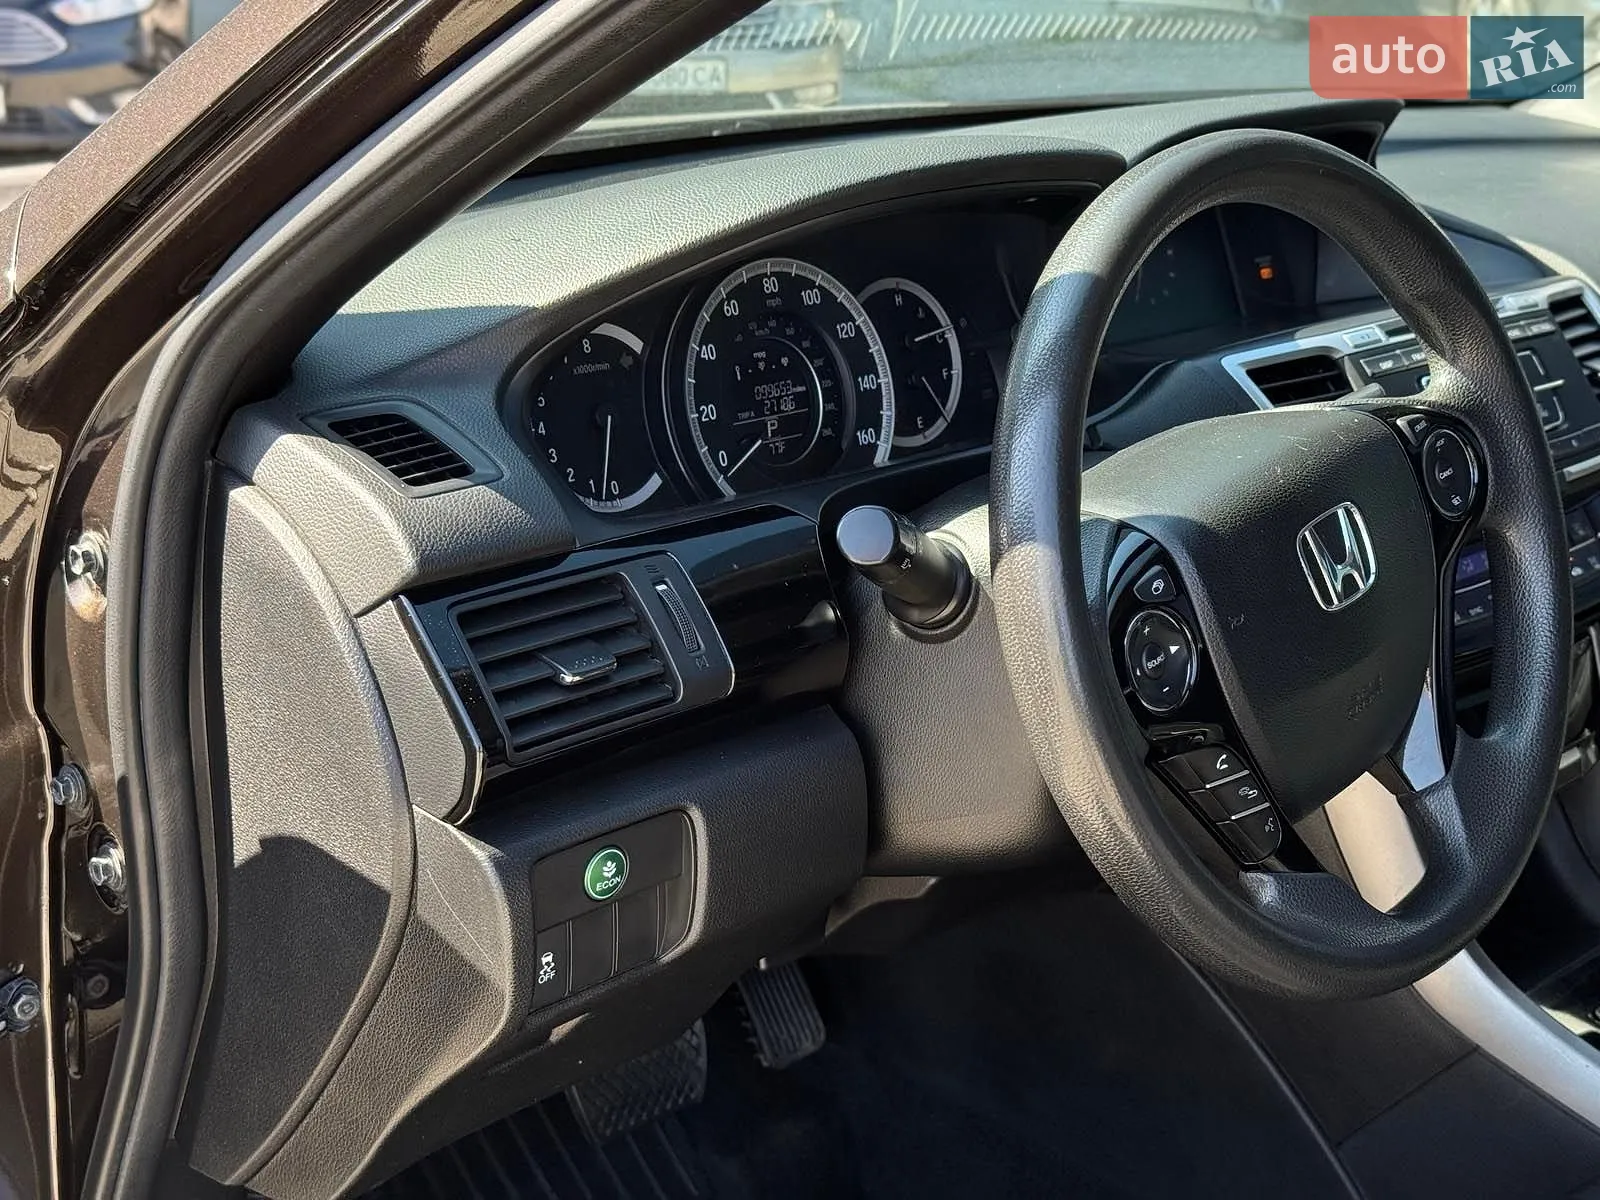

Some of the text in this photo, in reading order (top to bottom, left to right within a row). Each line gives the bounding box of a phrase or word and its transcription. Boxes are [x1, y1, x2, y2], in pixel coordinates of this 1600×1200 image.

[762, 276, 779, 294] 80
[766, 296, 783, 308] mph
[800, 288, 821, 306] 100
[894, 293, 903, 306] H
[723, 299, 740, 317] 60
[836, 321, 855, 339] 120
[582, 338, 592, 354] 8
[700, 343, 717, 361] 40
[942, 367, 949, 380] F
[754, 380, 793, 400] 099653
[857, 373, 877, 392] 140
[700, 404, 717, 422] 20
[537, 420, 547, 436] 4
[767, 419, 779, 438] P
[916, 416, 924, 428] E
[856, 427, 876, 446] 160
[548, 448, 558, 464] 3
[718, 450, 728, 467] 0
[567, 467, 576, 483] 2
[589, 479, 596, 494] 1
[611, 480, 619, 495] 0
[595, 875, 622, 892] ECON
[538, 970, 557, 985] OFF
